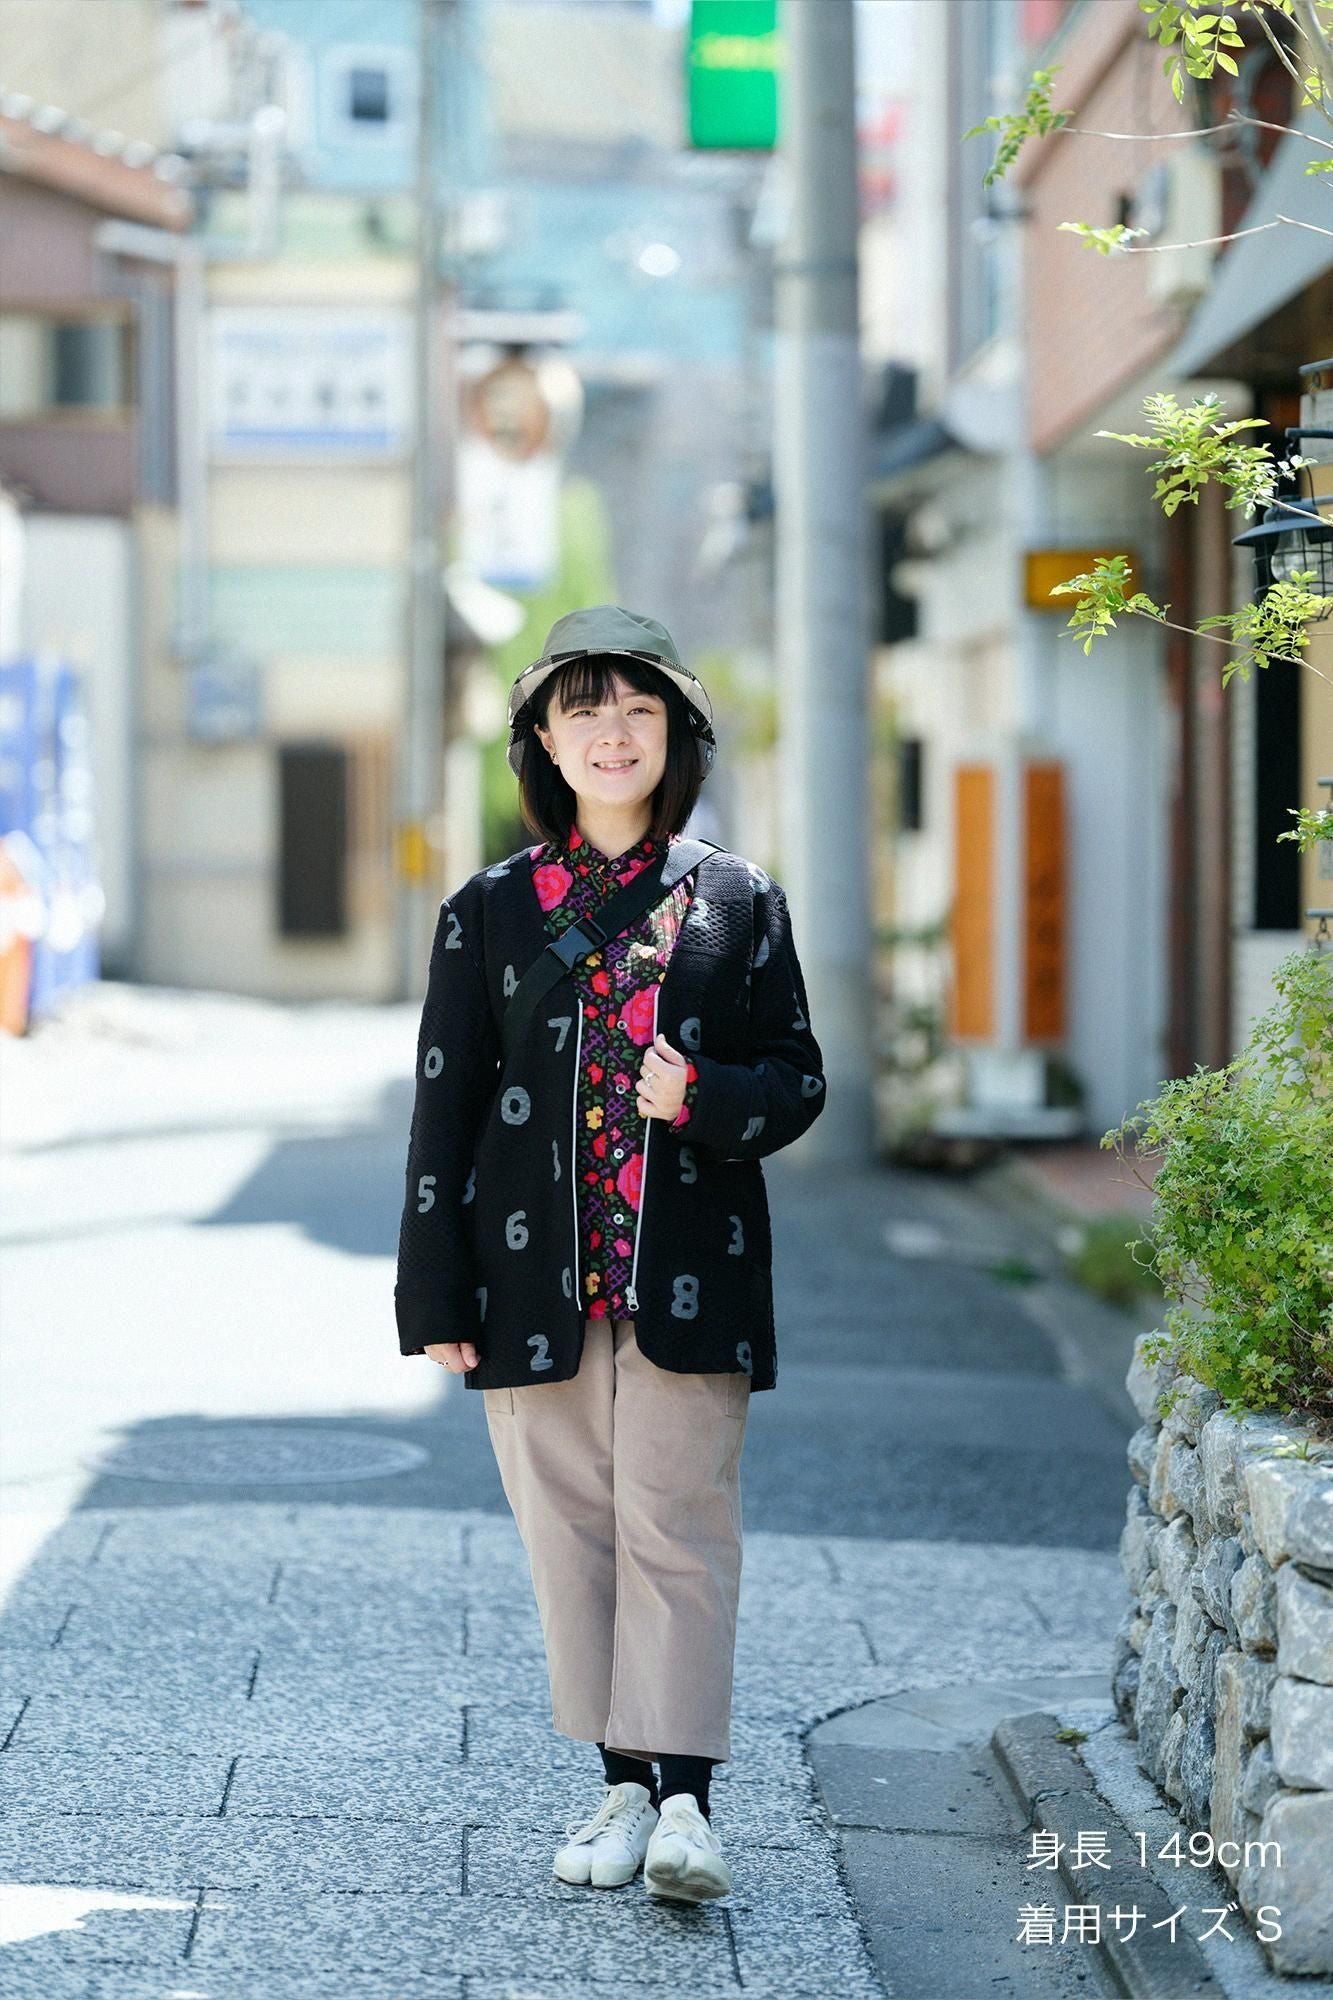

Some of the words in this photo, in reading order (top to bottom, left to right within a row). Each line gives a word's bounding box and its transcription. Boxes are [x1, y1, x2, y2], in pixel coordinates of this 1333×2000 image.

[445, 913, 463, 949] 2
[547, 1016, 572, 1052] 7
[500, 1086, 531, 1125] 0
[417, 1174, 437, 1213] 5
[505, 1210, 529, 1250] 6
[671, 1274, 700, 1320] 8
[526, 1333, 554, 1372] 2
